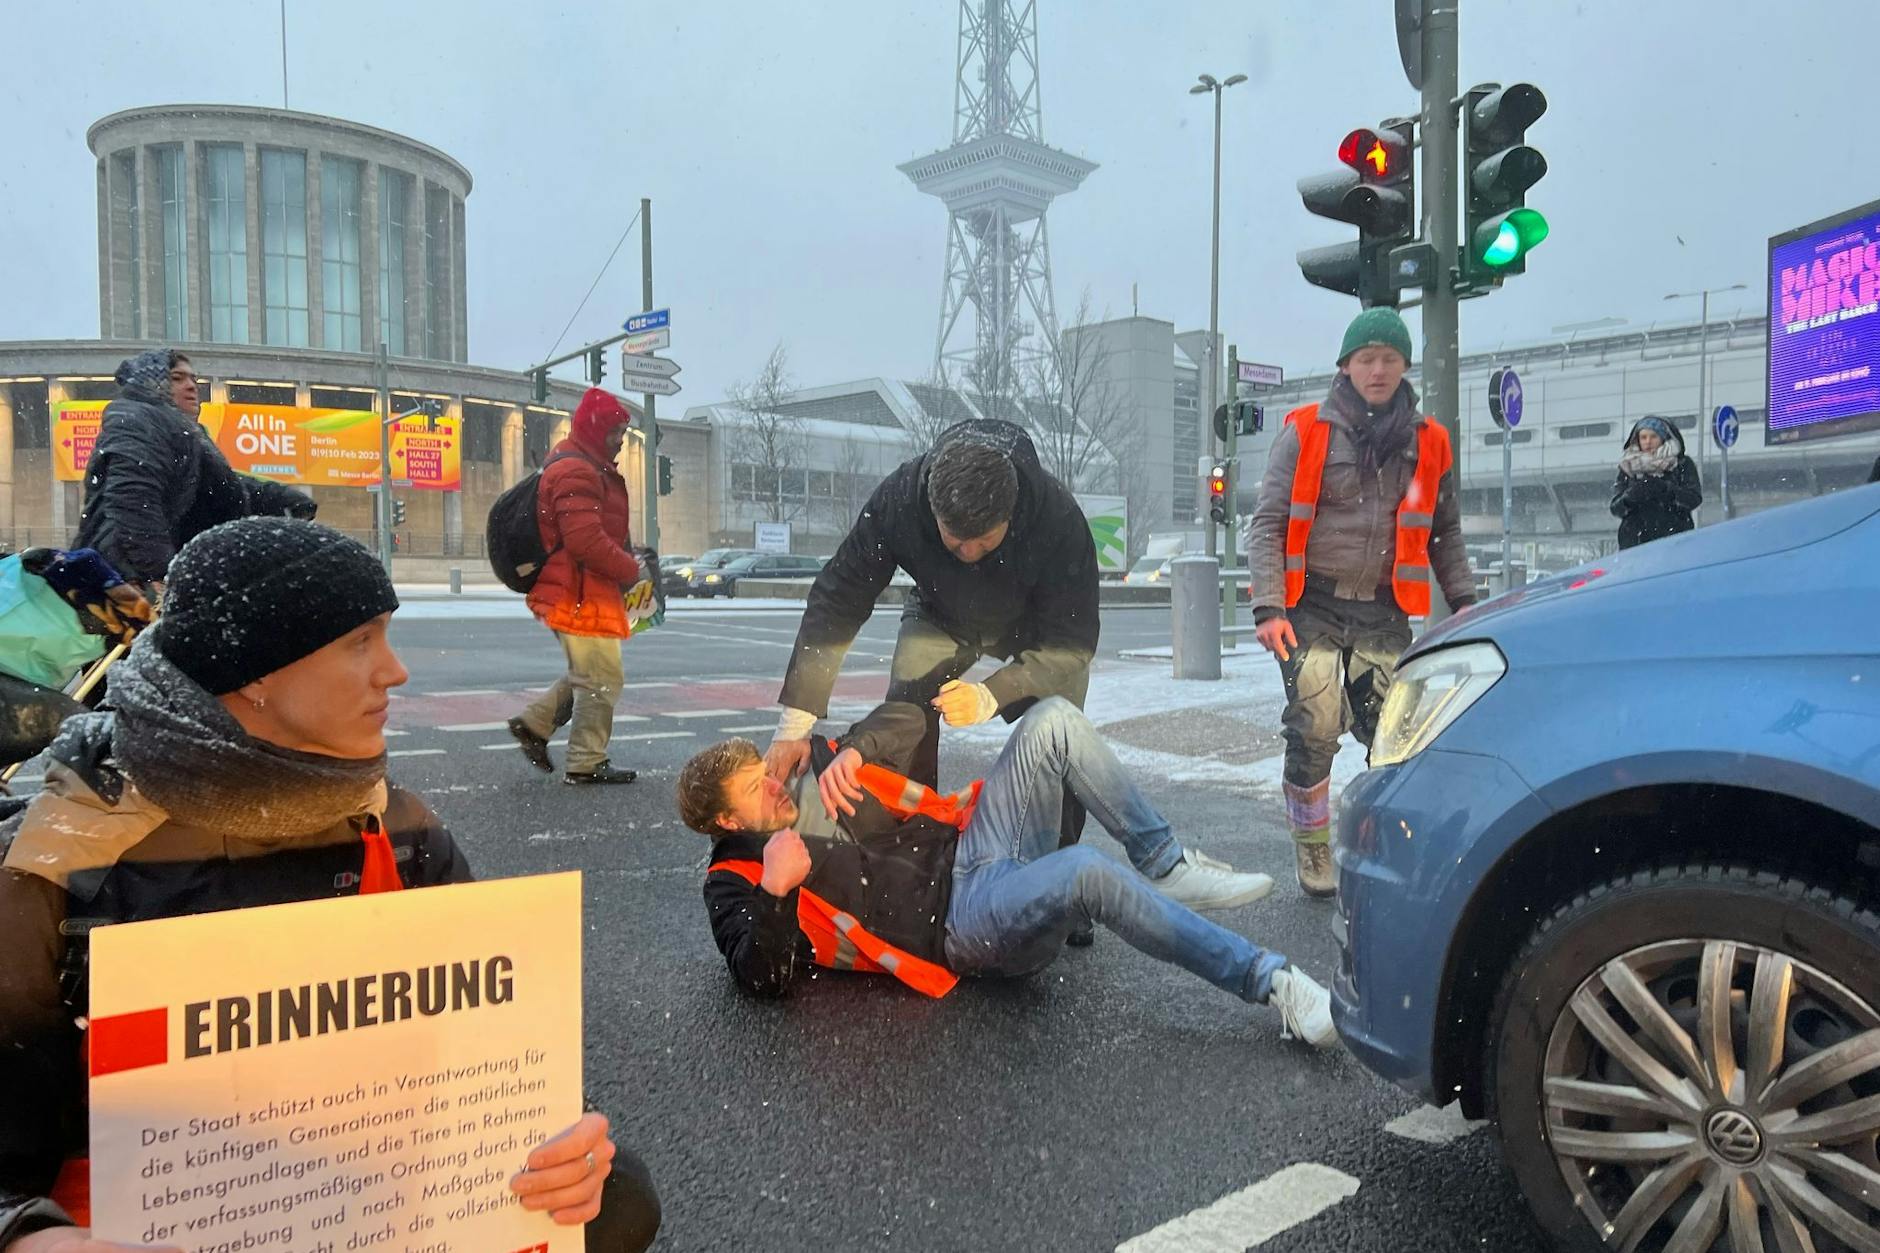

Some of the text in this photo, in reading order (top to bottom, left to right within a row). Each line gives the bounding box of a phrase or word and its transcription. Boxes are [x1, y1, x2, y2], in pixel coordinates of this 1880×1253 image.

[66, 411, 101, 420] ENTRAN
[236, 414, 264, 430] All
[235, 433, 297, 456] ONE
[311, 436, 337, 445] Berlin
[408, 438, 439, 447] NORTH
[340, 450, 357, 460] Feb
[358, 451, 380, 460] 2023
[409, 450, 429, 460] HALL
[409, 460, 438, 469] SOUTH
[409, 470, 430, 479] HALL
[184, 955, 514, 1060] ERINNERUNG
[142, 1048, 547, 1147] Der Staat schützt auch in Verantwortung für
[141, 1077, 546, 1179] die künftigen Generationen die natürlichen
[141, 1105, 547, 1211] Lebensgrundlagen und die Tiere im Rahmen
[141, 1129, 547, 1244] der verfassungsmäßigen Ordnung durch die
[192, 1225, 294, 1253] tzgebung
[311, 1204, 346, 1231] und
[362, 1191, 406, 1218] nach
[421, 1166, 505, 1202] Maßgabe
[346, 1223, 397, 1251] durch
[408, 1214, 435, 1235] die
[446, 1190, 525, 1222] vollziehe
